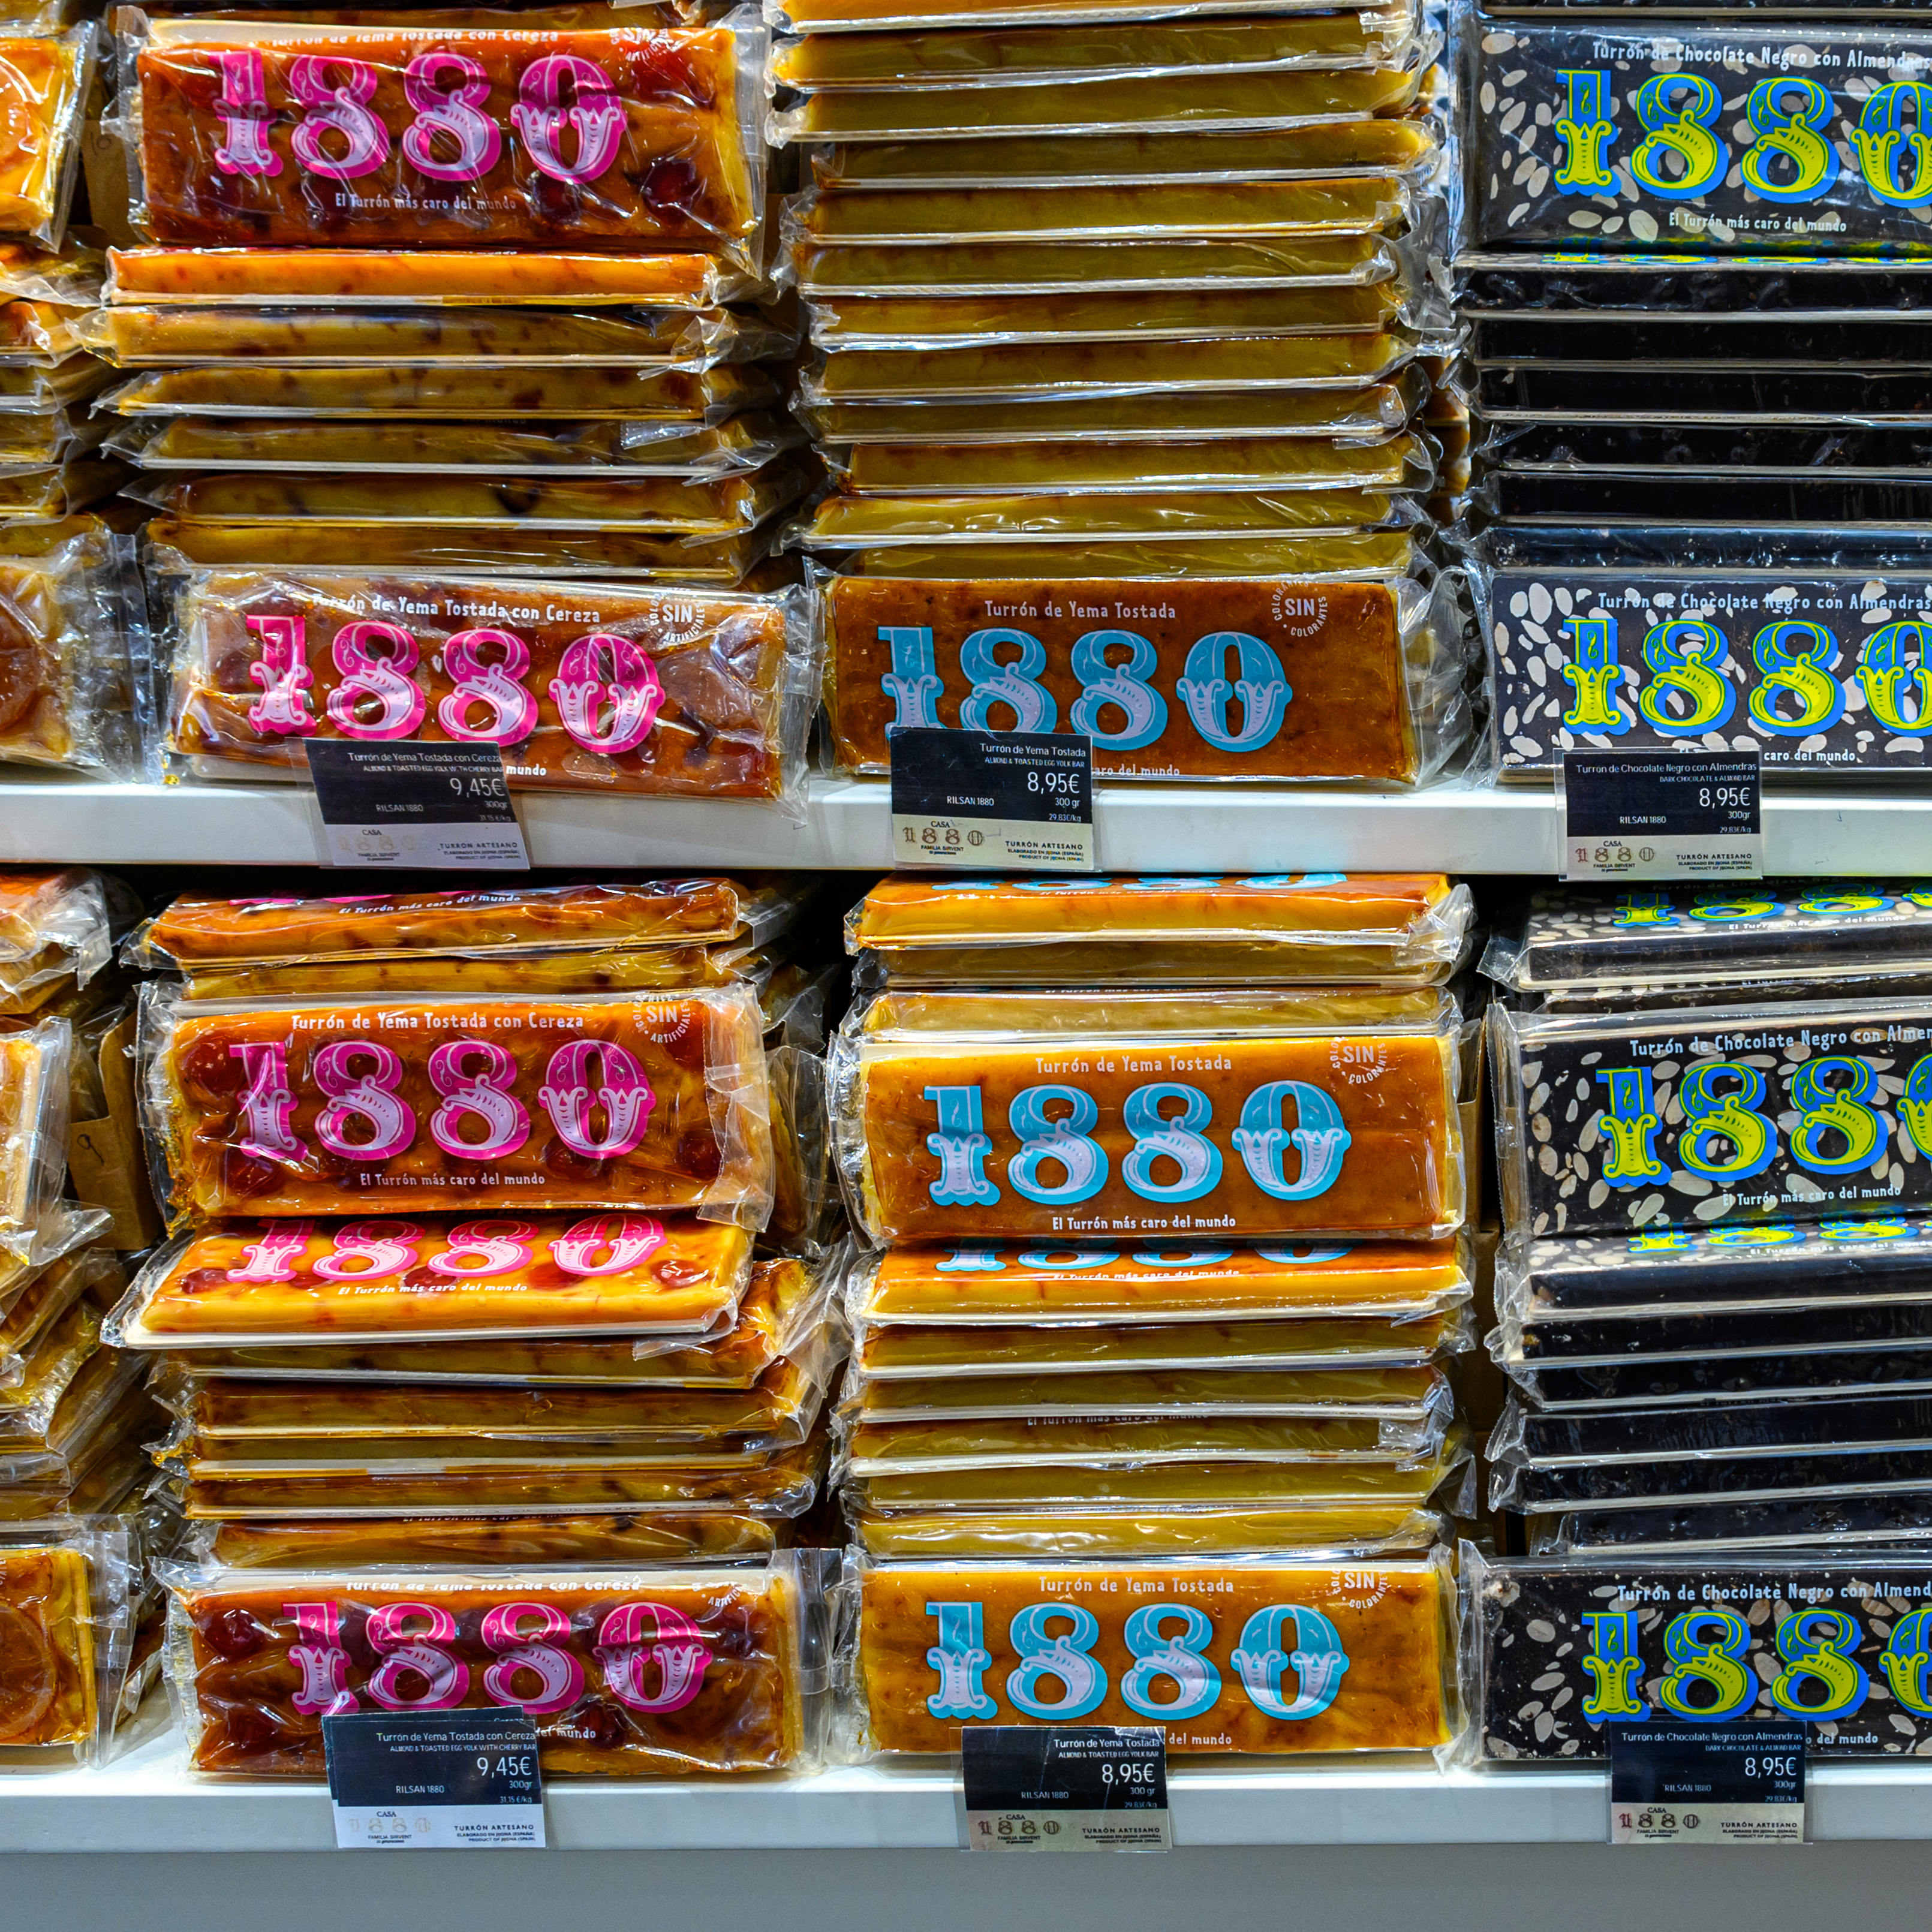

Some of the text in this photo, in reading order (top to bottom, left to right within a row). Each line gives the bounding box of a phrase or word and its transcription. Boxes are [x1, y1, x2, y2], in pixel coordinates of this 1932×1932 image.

[1593, 43, 1644, 59] Turrón
[1652, 43, 1669, 60] de
[1676, 41, 1755, 63] Chocolate
[1761, 47, 1810, 70] Negro
[1814, 53, 1841, 67] con
[208, 49, 622, 183] 1880
[1669, 212, 1847, 231] El Turrón más caro del mundo
[985, 600, 1175, 619] Turrón de Yema Tostada
[1284, 598, 1315, 616] SIN
[1598, 592, 1931, 614] Turrón de Chocolate Negro con Almendras
[662, 604, 693, 623] SIN
[1290, 596, 1328, 637] COLORANTES
[246, 614, 666, 753] 1880
[878, 626, 1293, 752] 1880
[980, 743, 1086, 757] Turrón de Yema Tostada
[1764, 748, 1856, 762] caro del mundo
[505, 763, 547, 776] mundo
[1576, 763, 1607, 774] Turrón
[1609, 765, 1620, 773] de
[1621, 763, 1665, 773] Chocolate
[1666, 764, 1690, 775] Negro
[1710, 762, 1757, 772] Almendras
[450, 778, 505, 798] 9,45€
[1027, 772, 1080, 794] 8,95€
[947, 796, 994, 806] RILSAN 1880
[1055, 798, 1080, 808] 300 gr
[1699, 787, 1751, 809] 8,95€
[1620, 816, 1648, 824] RILSAN
[1728, 811, 1751, 820] 300gr
[291, 1012, 583, 1030] Turrón de Yema Tostada con Cereza
[646, 1004, 678, 1023] SIN
[650, 1001, 691, 1043] ARTIFICIALES
[1630, 1038, 1683, 1056] Turrón
[1693, 1036, 1710, 1052] de
[1715, 1033, 1795, 1052] Chocolate
[1801, 1030, 1846, 1051] Negro
[1853, 1030, 1881, 1043] con
[1036, 1054, 1232, 1073] Turrón de Yema Tostada
[1343, 1045, 1374, 1063] SIN
[1348, 1042, 1388, 1084] COLORANTES
[228, 1040, 657, 1160] 1880
[924, 1080, 1352, 1206] 1880
[360, 1173, 545, 1186] El Turrón más caro del mundo
[1722, 1184, 1901, 1206] El Turrón más caro del mundo
[1052, 1214, 1236, 1230] El Turrón más caro del mundo
[227, 1212, 665, 1283] 1880
[354, 1286, 395, 1295] Turrón
[399, 1284, 425, 1293] más
[428, 1284, 456, 1292] caro
[1039, 1576, 1233, 1593] Turrón de Yema Tostada
[1344, 1572, 1375, 1589] SIN
[1618, 1584, 1670, 1601] Turrón
[1678, 1584, 1696, 1600] de
[1702, 1583, 1781, 1600] Chocolate
[1788, 1584, 1834, 1604] Negro
[1840, 1587, 1867, 1599] con
[282, 1602, 712, 1714] 1880
[925, 1601, 1350, 1721] 1880
[376, 1732, 408, 1742] Turrón
[410, 1732, 422, 1741] de
[423, 1732, 447, 1741] Yema
[449, 1732, 484, 1741] Tostada
[504, 1732, 535, 1741] Cereza
[555, 1726, 596, 1739] mundo
[1169, 1732, 1232, 1745] del mundo
[1817, 1732, 1834, 1744] del
[1838, 1732, 1879, 1744] mundo
[477, 1756, 532, 1778] 9,45€
[1102, 1764, 1155, 1785] 8,95€
[1744, 1757, 1797, 1778] 8,95€
[396, 1785, 444, 1794] RILSAN 1880
[509, 1780, 532, 1790] 300gr
